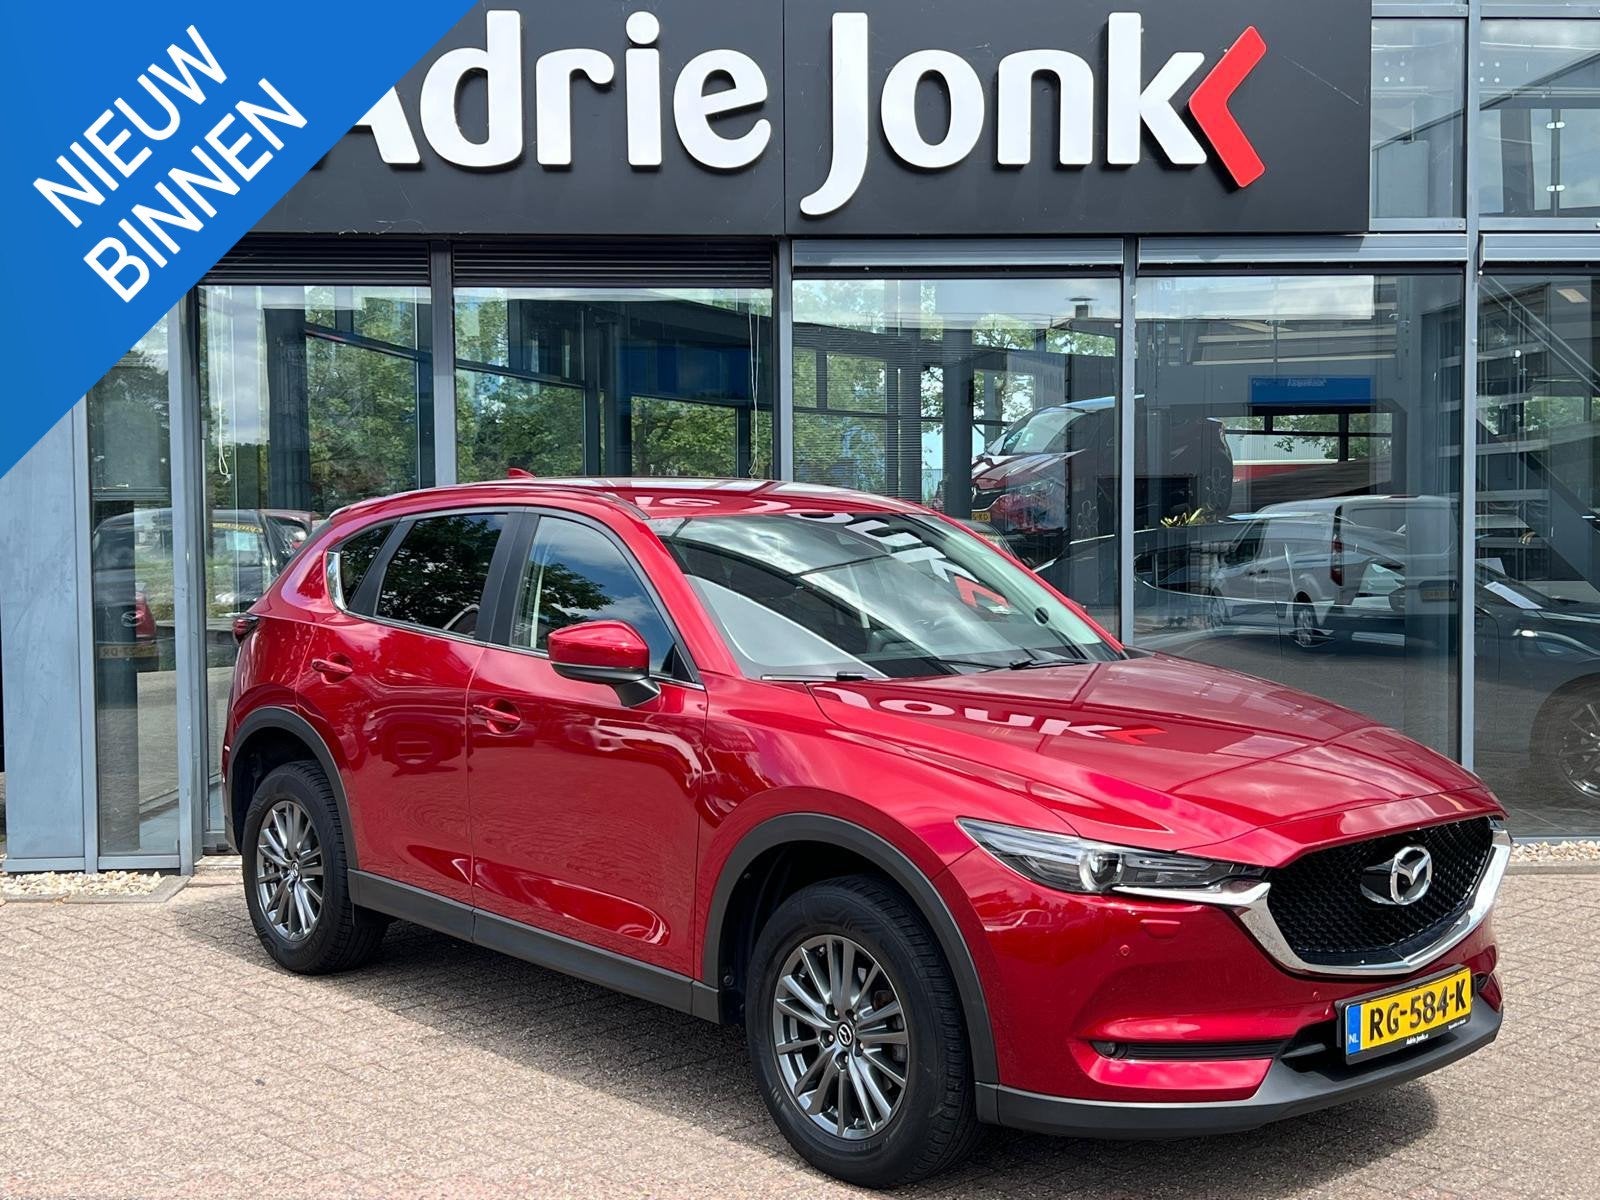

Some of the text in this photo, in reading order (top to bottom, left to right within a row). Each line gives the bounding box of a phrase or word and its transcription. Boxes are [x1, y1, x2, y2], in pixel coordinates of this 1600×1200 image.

[799, 11, 1208, 216] Jonk
[1348, 1032, 1360, 1045] NL
[1369, 978, 1467, 1041] RG-584-K
